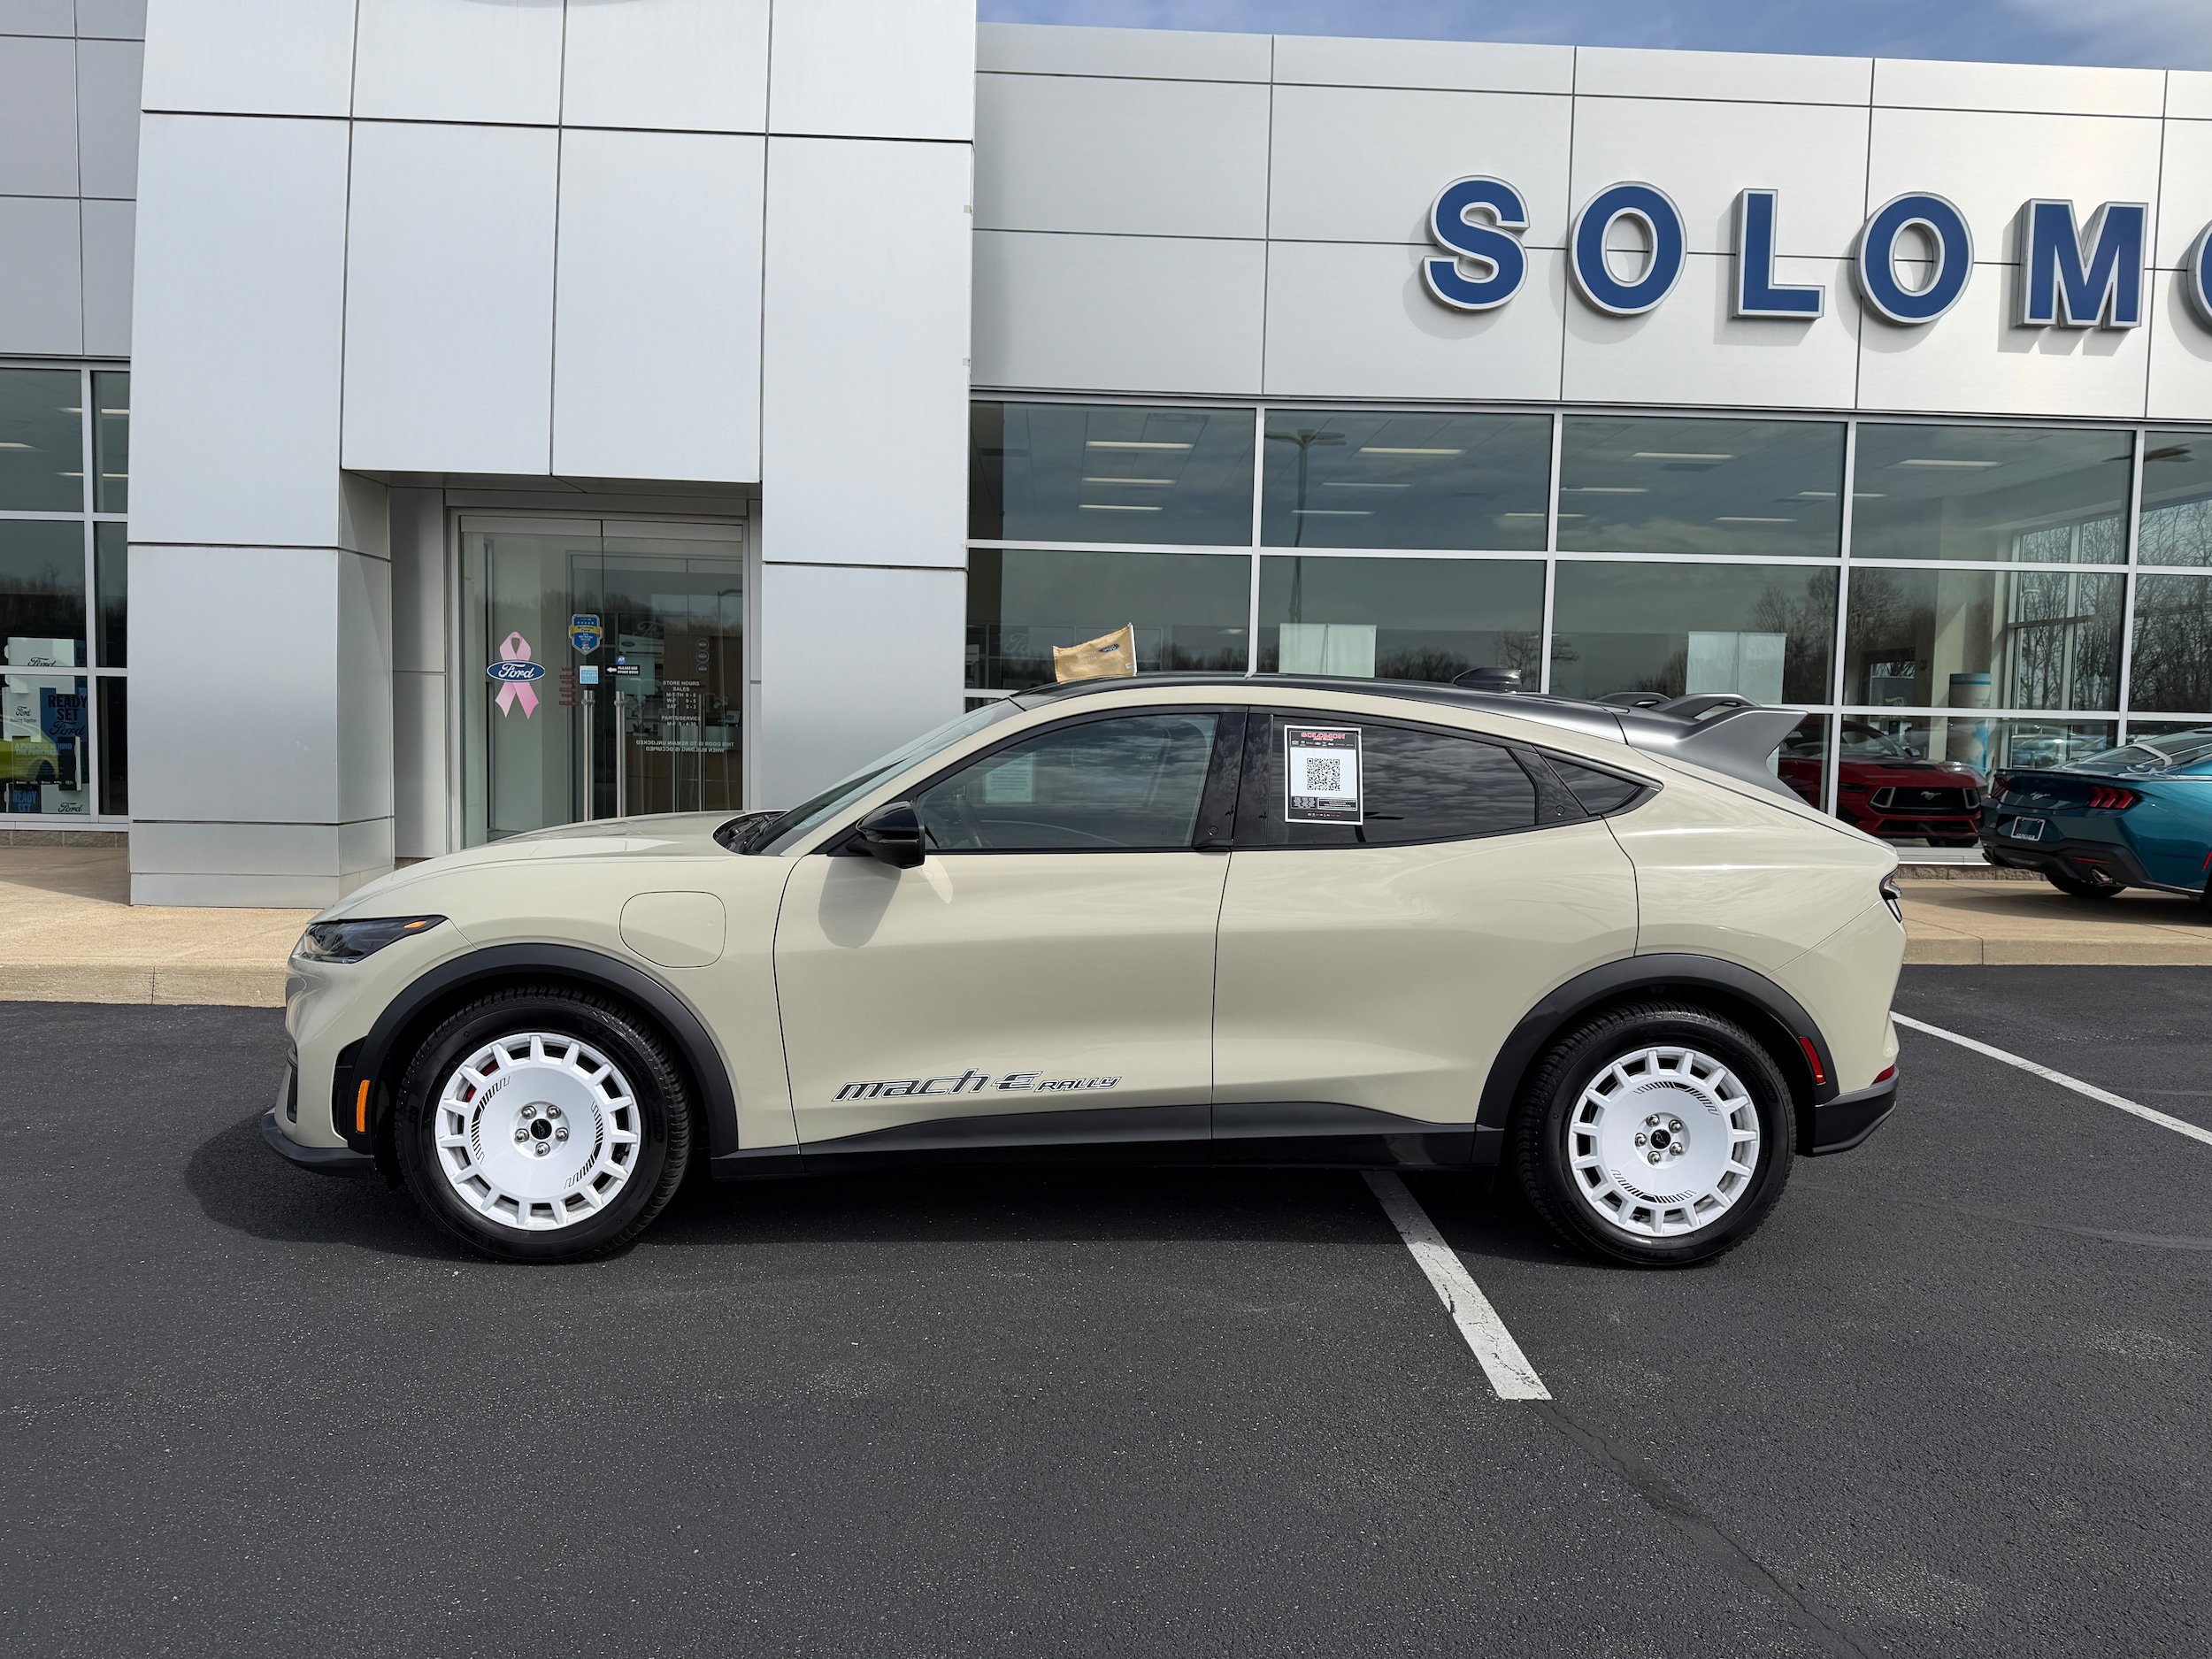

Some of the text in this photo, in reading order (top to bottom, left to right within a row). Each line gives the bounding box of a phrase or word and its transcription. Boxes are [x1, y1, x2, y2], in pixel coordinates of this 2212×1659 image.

[1423, 174, 2212, 334] SOLOM
[498, 663, 534, 678] Ford
[48, 695, 88, 708] READY
[16, 706, 31, 717] Ford
[57, 709, 80, 721] SET
[50, 721, 85, 736] Ford
[13, 790, 36, 803] READY
[58, 803, 83, 812] Ford
[1033, 1076, 1123, 1093] RALLY
